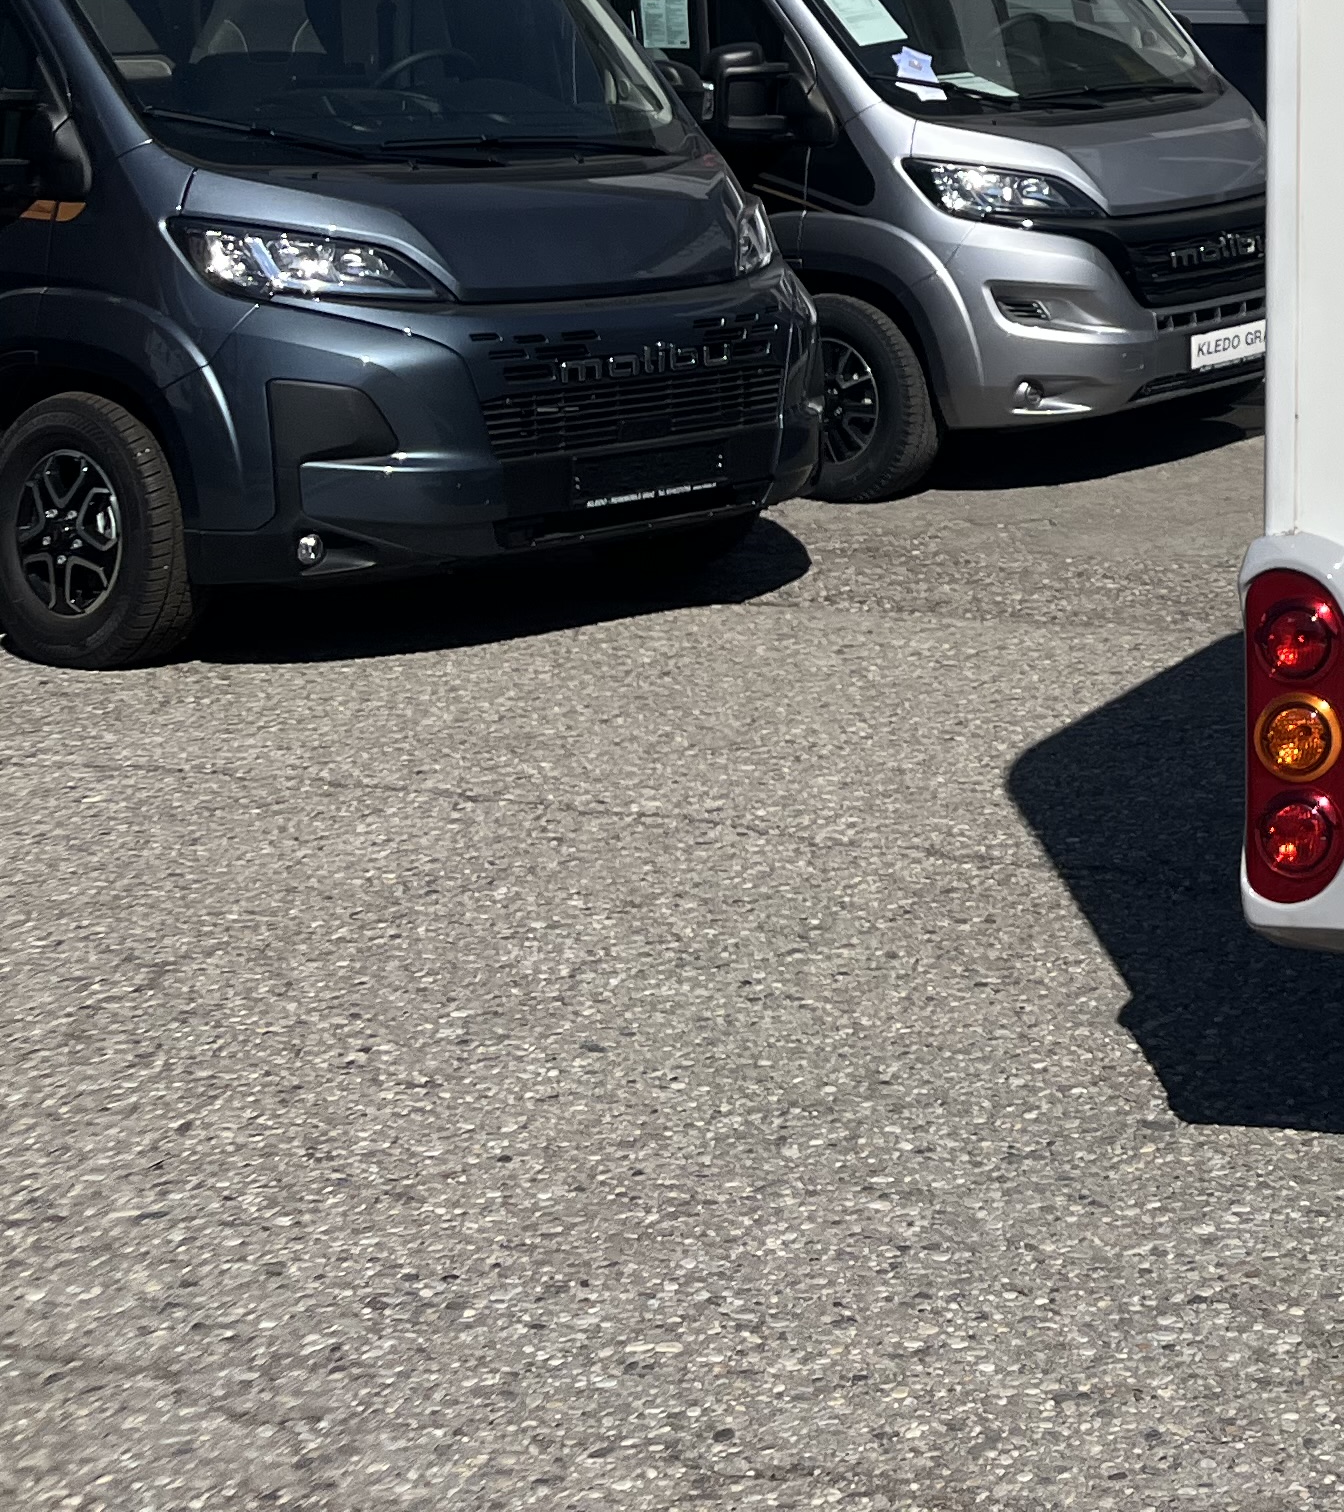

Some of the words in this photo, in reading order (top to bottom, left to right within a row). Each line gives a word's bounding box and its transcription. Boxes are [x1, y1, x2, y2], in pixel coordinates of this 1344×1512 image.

[1197, 334, 1241, 357] KLEDO
[1245, 329, 1266, 346] GR
[561, 341, 730, 383] malibu
